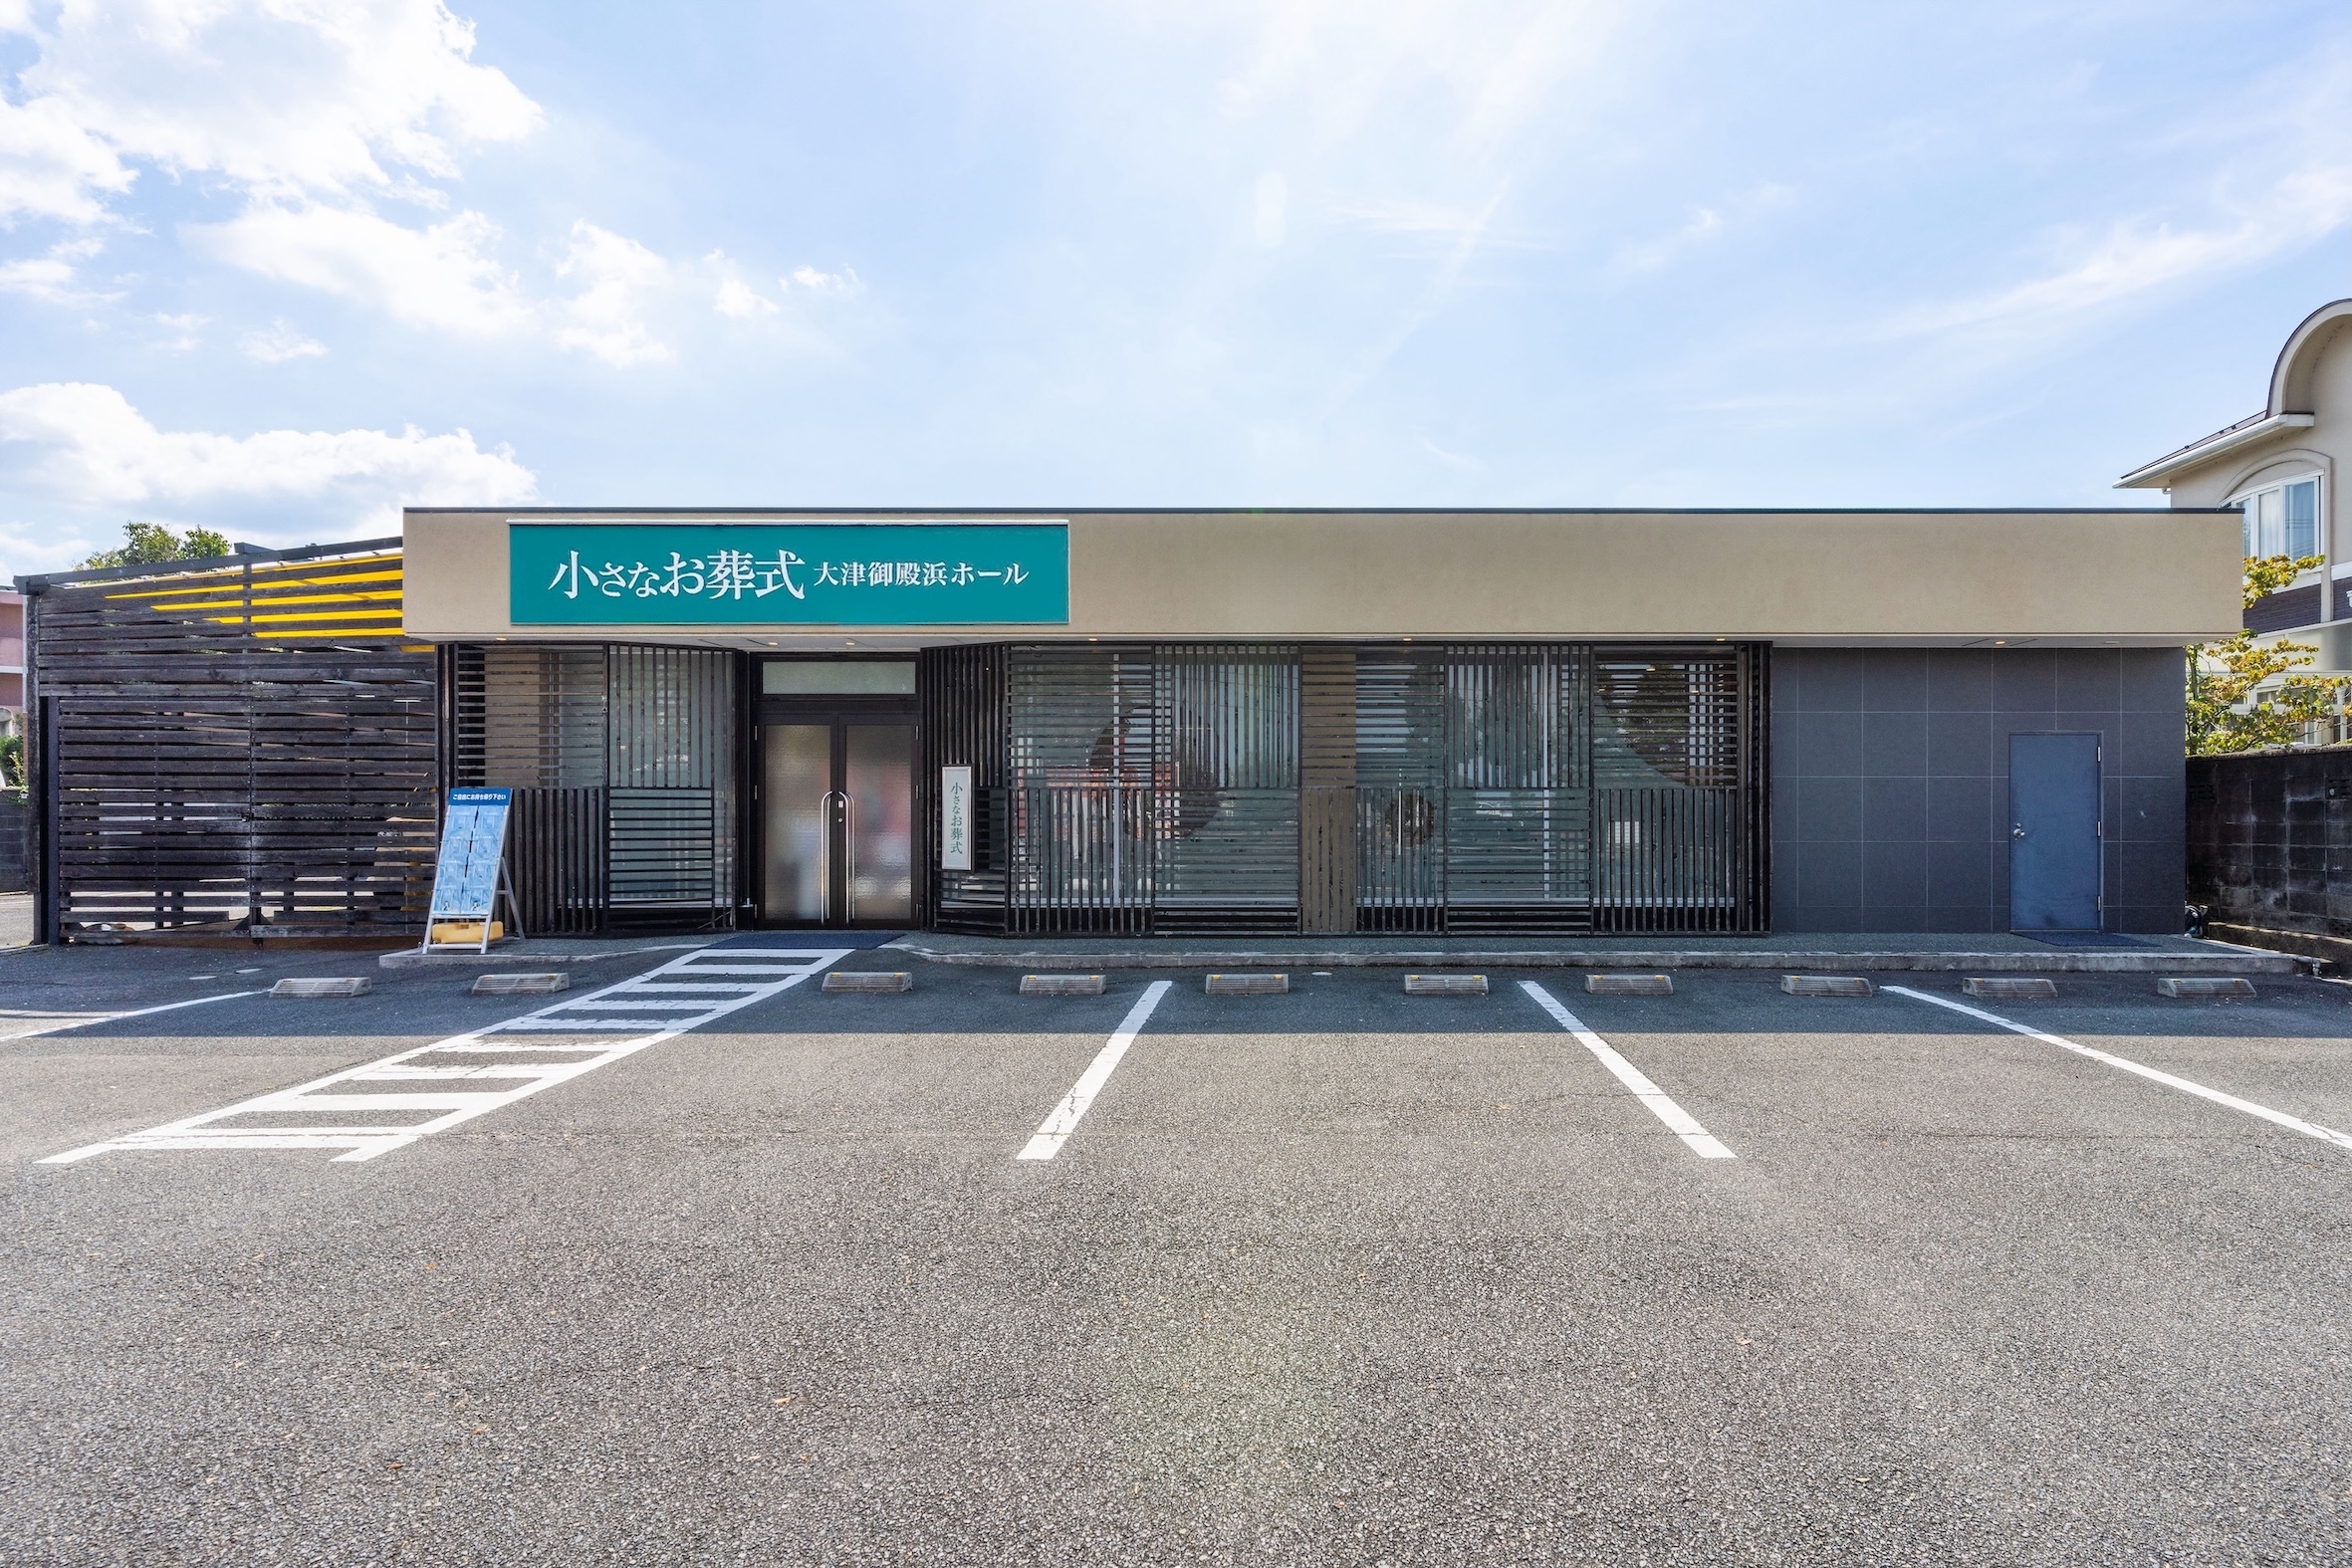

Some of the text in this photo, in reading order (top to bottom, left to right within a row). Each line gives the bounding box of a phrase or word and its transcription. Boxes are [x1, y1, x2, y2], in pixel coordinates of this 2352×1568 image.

[549, 550, 1030, 599] 小さなお葬式 大津御殿浜ホール
[950, 782, 963, 854] 小さなお葬式
